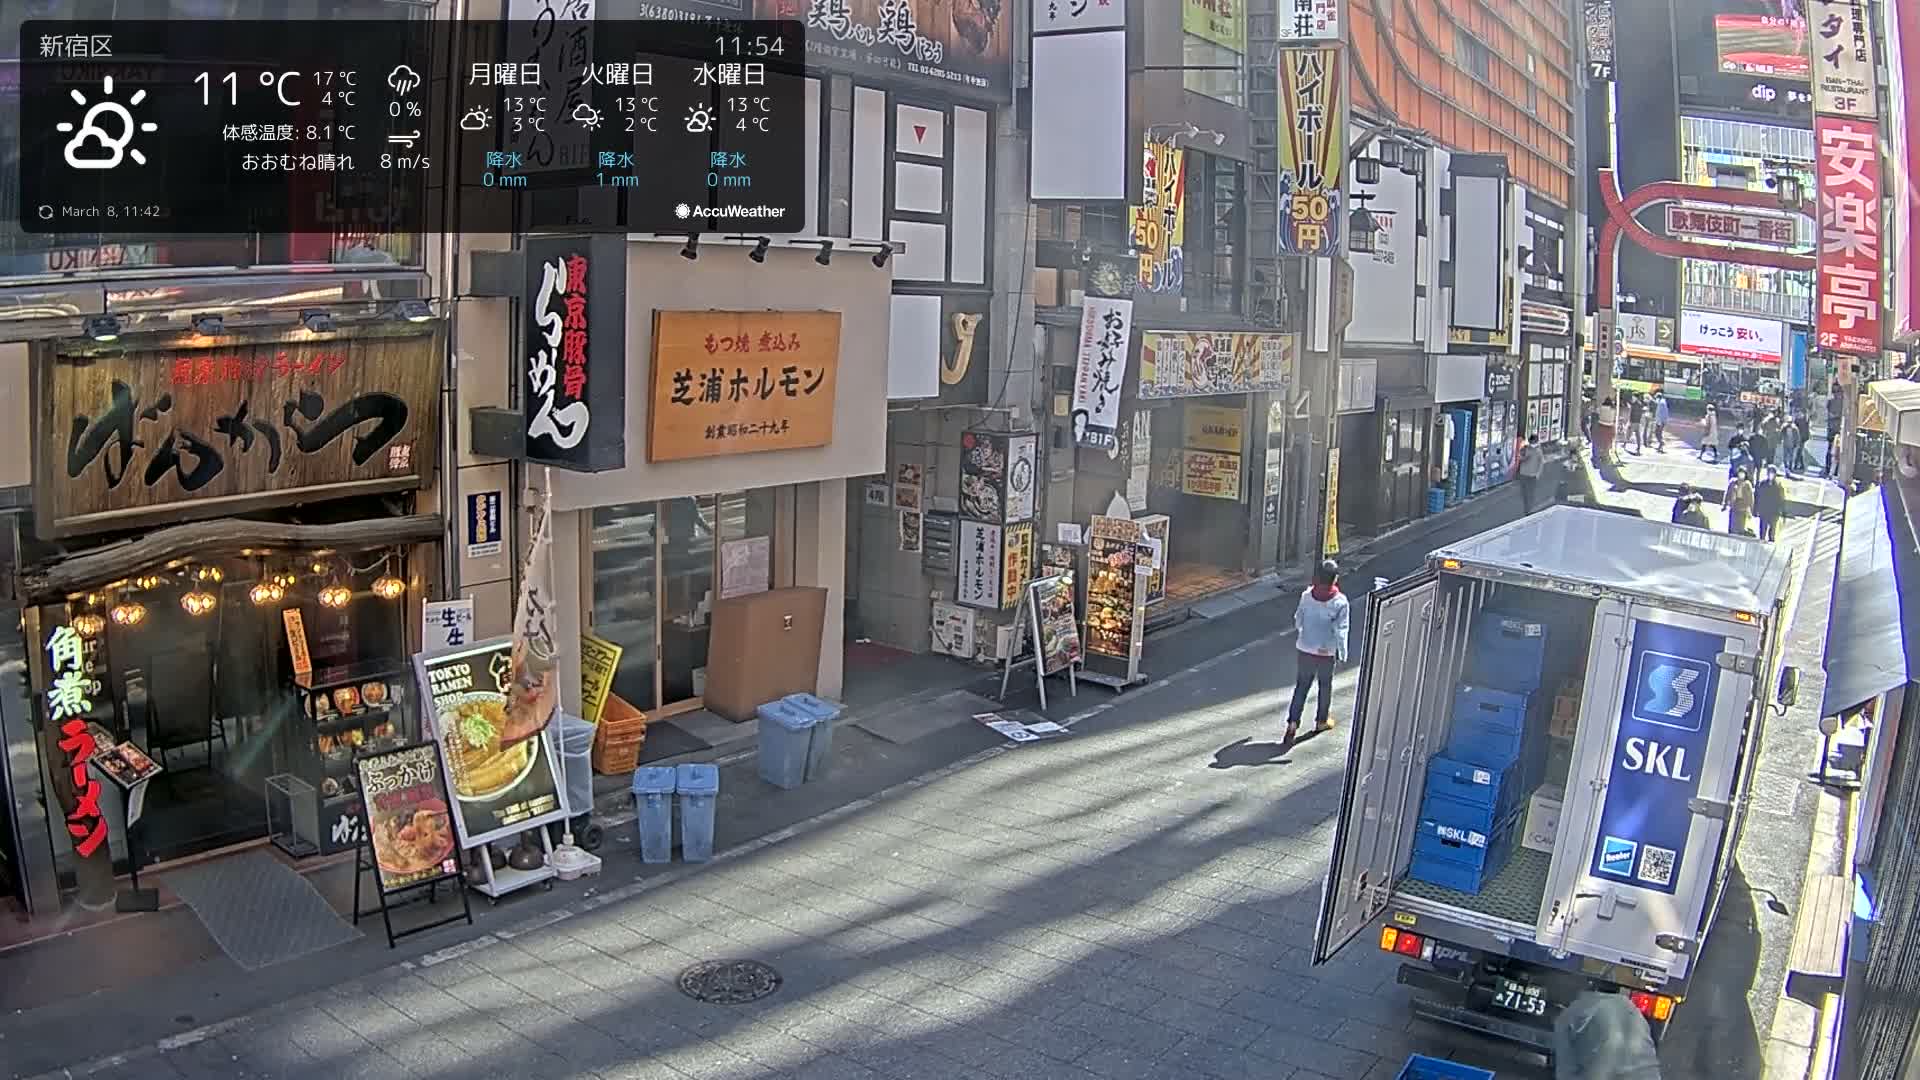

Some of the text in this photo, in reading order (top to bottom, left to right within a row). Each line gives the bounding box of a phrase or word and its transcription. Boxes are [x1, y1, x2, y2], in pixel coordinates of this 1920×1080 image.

[1819, 0, 1845, 69] タイ
[1591, 63, 1611, 78] 7F
[1752, 83, 1776, 101] dip
[1834, 97, 1857, 111] 3F
[1296, 52, 1324, 190] ハイボール
[1671, 210, 1792, 241] 歌舞伎町一番街
[1820, 126, 1878, 330] 安楽亭
[563, 254, 588, 401] 東京豚骨
[1699, 324, 1764, 343] けっこう安い。
[1820, 332, 1838, 347] 2F
[704, 331, 801, 355] もつ焼 煮込み
[670, 366, 827, 407] 芝浦ホルモン
[66, 378, 409, 492] ばんから
[704, 419, 790, 441] 創業昭和二十九年
[428, 663, 471, 684] TOKYO
[431, 675, 474, 696] RAMEN
[433, 691, 465, 707] SHOP
[1622, 737, 1692, 782] SKL
[367, 759, 437, 793] ぶっかけ
[1504, 987, 1546, 1015] 71-53
